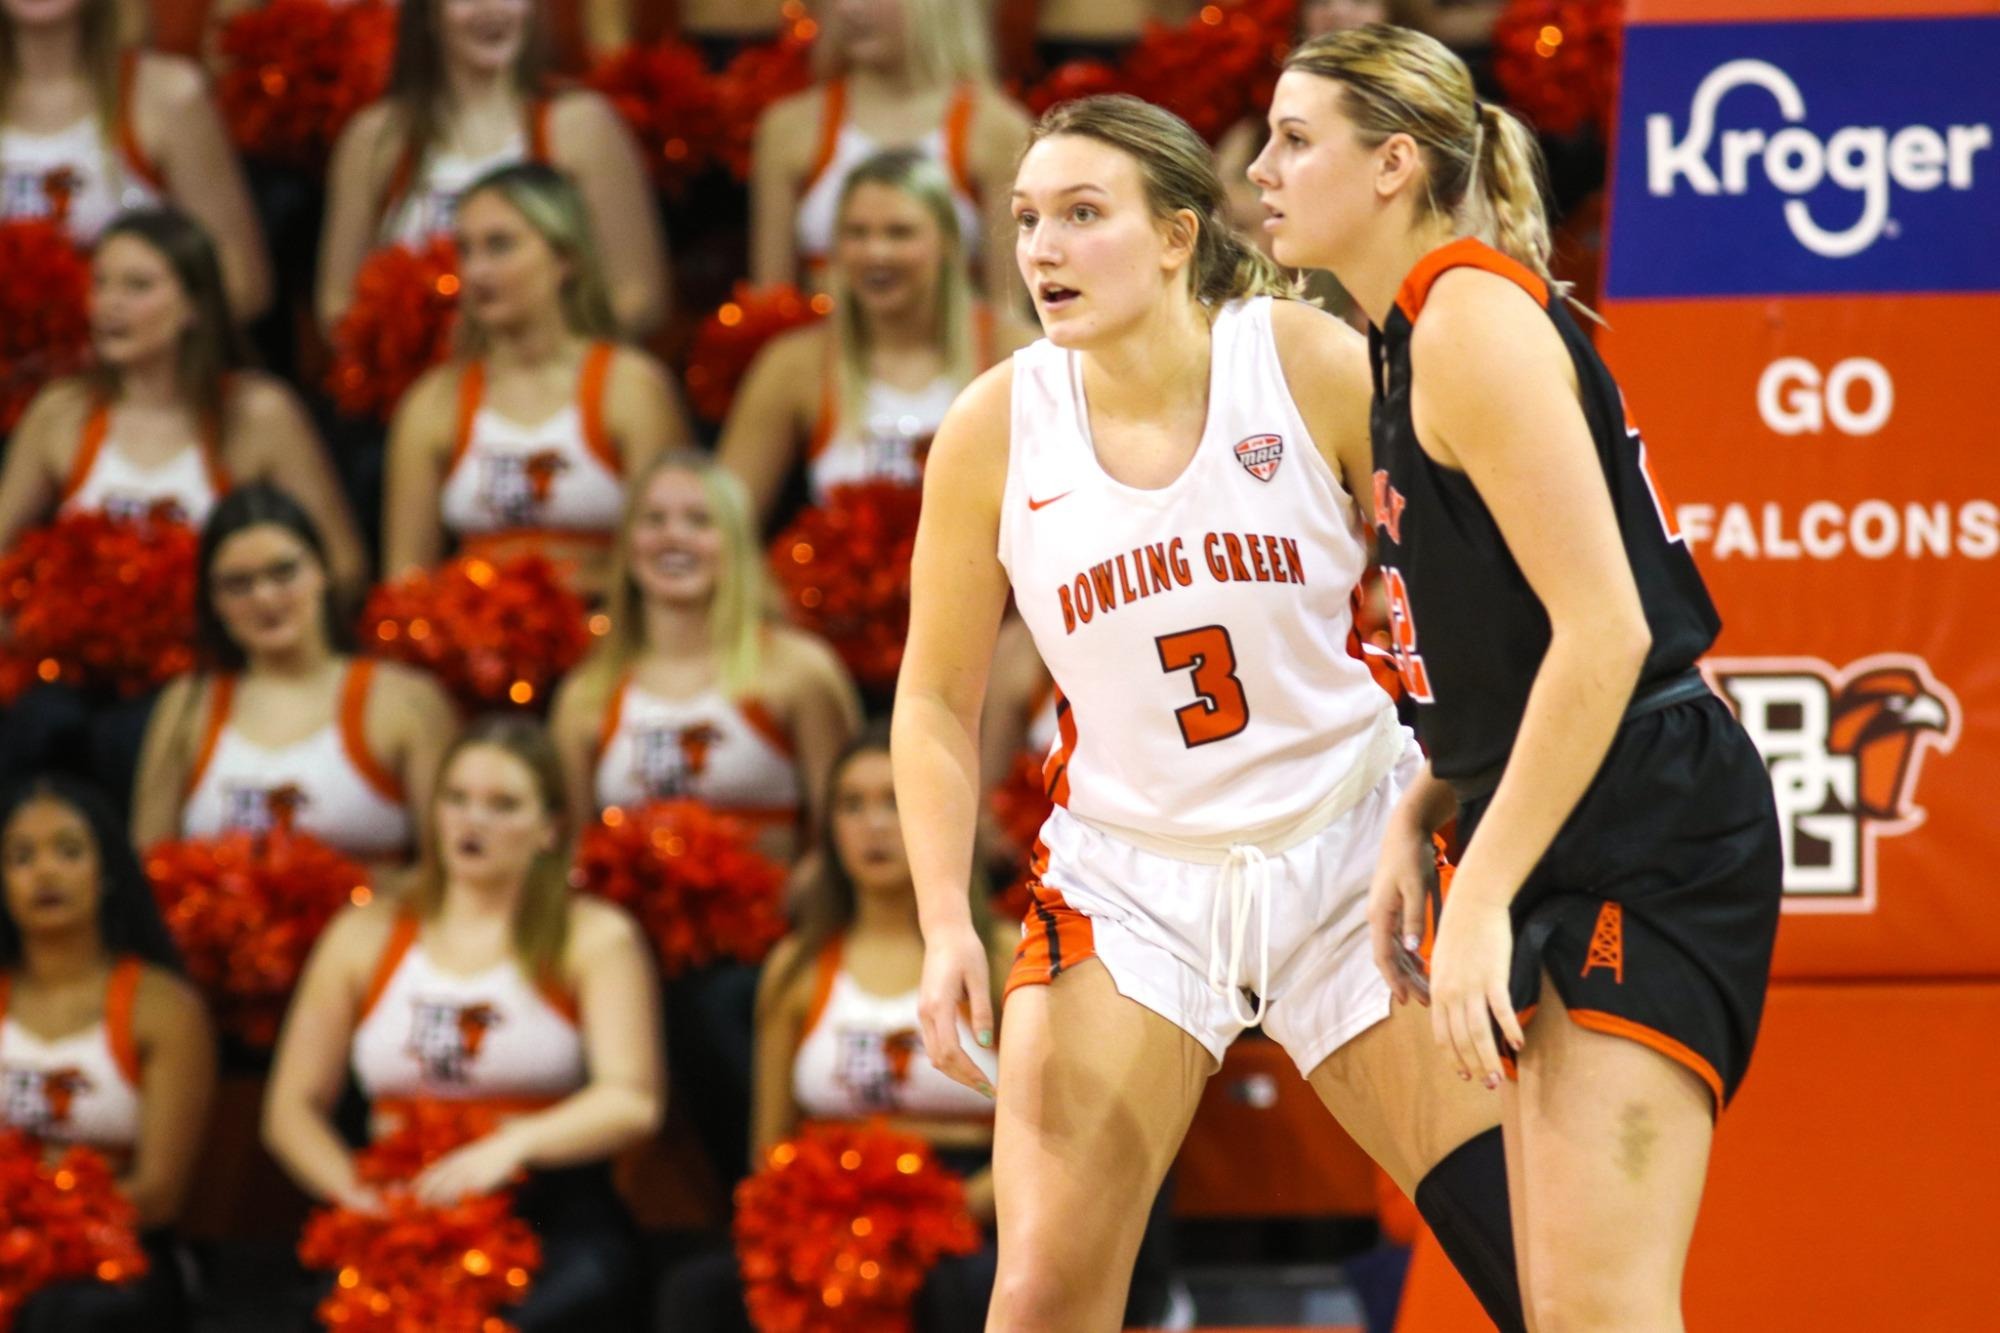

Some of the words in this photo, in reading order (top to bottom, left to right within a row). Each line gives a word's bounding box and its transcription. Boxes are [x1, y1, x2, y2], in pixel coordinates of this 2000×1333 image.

[1646, 58, 1991, 258] Kroger
[1757, 357, 1894, 436] GO
[1239, 444, 1282, 467] MAC
[1676, 499, 2000, 560] FALCONS
[1058, 537, 1192, 635] BOWLING
[1204, 532, 1305, 585] GREEN
[1154, 624, 1249, 749] 3
